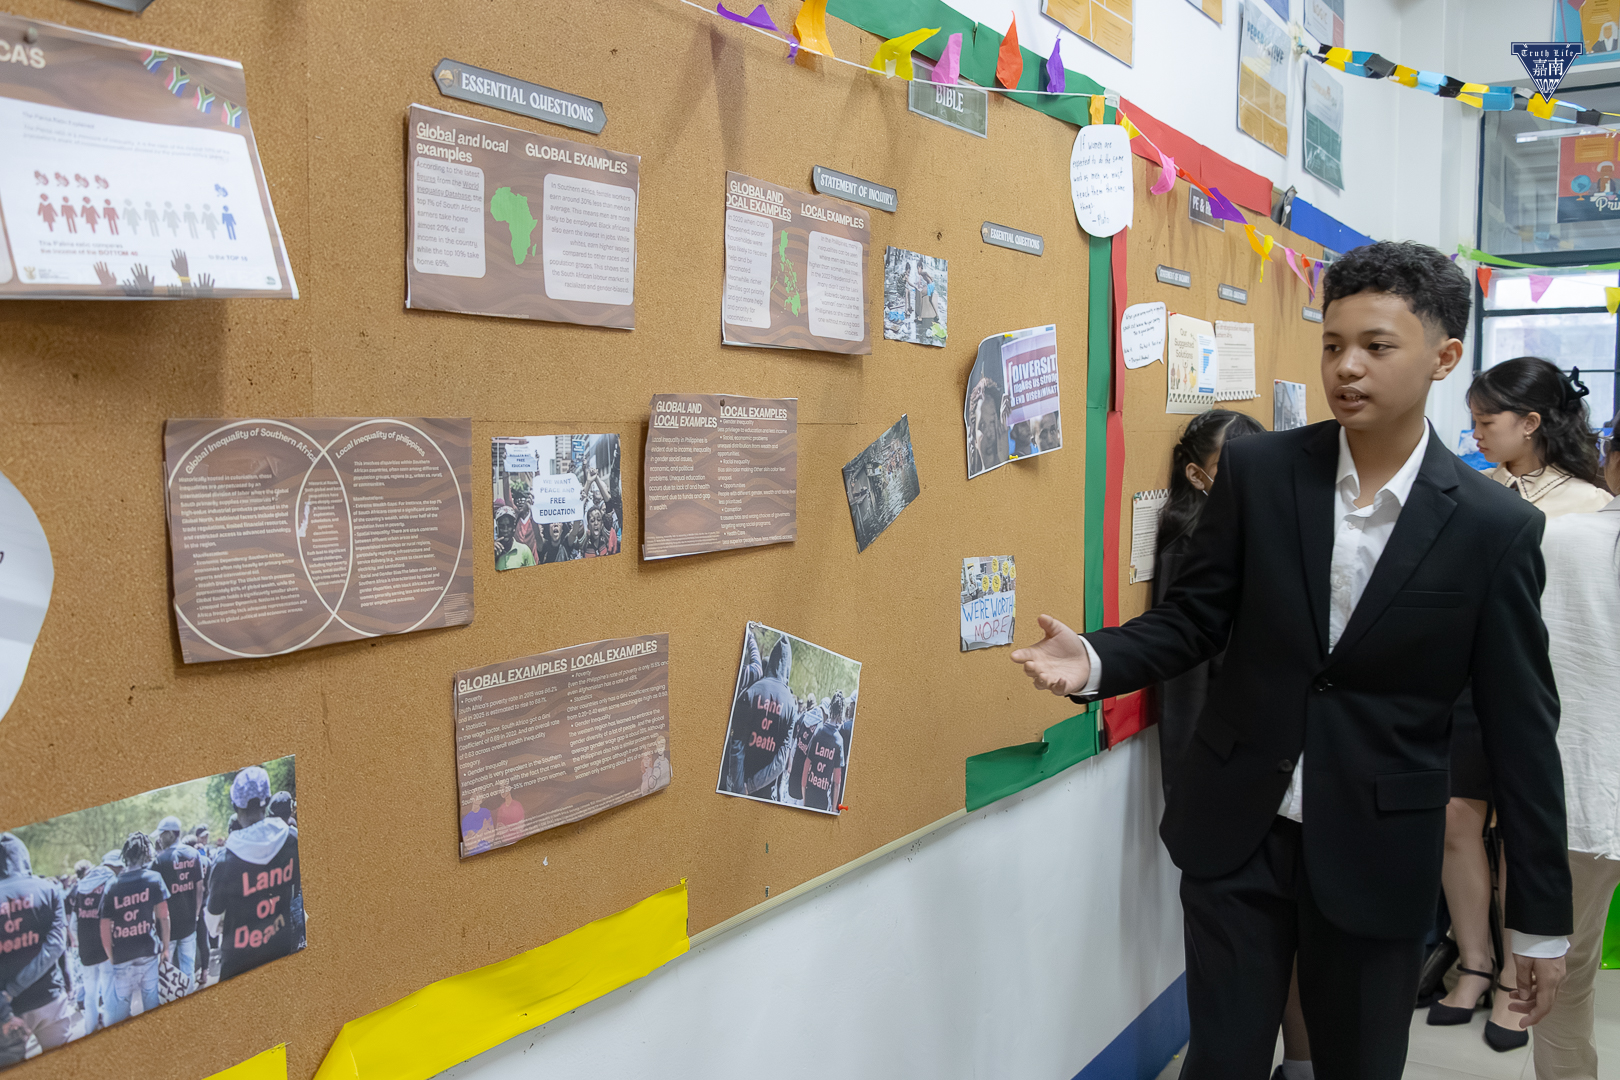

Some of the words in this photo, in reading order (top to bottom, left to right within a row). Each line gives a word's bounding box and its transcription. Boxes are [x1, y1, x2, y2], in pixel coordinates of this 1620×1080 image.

[462, 73, 526, 105] ESSENTIAL
[530, 92, 593, 123] QUESTIONS
[936, 84, 964, 113] BIBLE
[417, 122, 455, 140] Global
[458, 132, 479, 149] and
[482, 134, 508, 153] local
[417, 142, 472, 163] examples
[526, 143, 572, 164] GLOBAL
[574, 153, 628, 174] EXAMPLES
[1091, 154, 1096, 164] to
[416, 160, 445, 173] According
[453, 167, 463, 175] the
[451, 178, 461, 186] the
[462, 180, 479, 189] World
[821, 174, 857, 195] STATEMENT
[858, 185, 867, 198] OF
[869, 188, 894, 206] INQUIRY
[1091, 185, 1103, 196] them
[730, 180, 766, 199] GLOBAL
[767, 190, 783, 204] AND
[416, 197, 426, 205] top
[435, 199, 441, 207] of
[442, 201, 459, 210] South
[750, 198, 792, 220] EXAMPLES
[1192, 196, 1199, 210] PE
[1200, 198, 1205, 213] &
[438, 212, 451, 220] take
[452, 214, 468, 223] home
[801, 203, 827, 220] LOCAL
[827, 211, 864, 229] EXAMPLES
[436, 223, 449, 232] 20%
[450, 225, 457, 233] of
[444, 236, 454, 244] the
[990, 228, 1014, 243] ESSENTIAL
[1015, 235, 1040, 250] QUESTIONS
[416, 257, 434, 265] home
[467, 251, 479, 259] take
[1176, 349, 1193, 359] Solutions
[1014, 380, 1032, 393] makes
[1032, 378, 1040, 388] us
[656, 401, 685, 413] GLOBAL
[687, 403, 702, 413] AND
[720, 406, 747, 417] LOCAL
[749, 407, 787, 419] EXAMPLES
[654, 415, 679, 427] LOCAL
[680, 416, 717, 428] EXAMPLES
[185, 448, 209, 474] Global
[208, 430, 249, 452] Inequality
[250, 428, 260, 437] of
[260, 428, 297, 446] Southern
[335, 440, 354, 459] Local
[354, 431, 388, 446] Inequality
[388, 431, 396, 439] of
[396, 434, 425, 457] philippines
[540, 508, 576, 516] EDUCATION
[991, 595, 1013, 618] WORTH
[975, 615, 1009, 641] MORE
[570, 652, 605, 669] LOCAL
[606, 640, 658, 661] EXAMPLES
[458, 674, 505, 693] GLOBAL
[507, 659, 568, 682] EXAMPLES
[575, 670, 592, 679] Poverty
[464, 694, 482, 705] Poverty
[573, 692, 592, 702] Statistics
[757, 695, 784, 715] Land
[465, 720, 486, 731] Statistics
[574, 718, 590, 727] Gender
[762, 718, 773, 730] or
[815, 742, 835, 760] Land
[467, 766, 484, 776] Gender
[817, 762, 826, 772] or
[173, 858, 195, 870] Land
[179, 872, 189, 881] or
[242, 858, 293, 897] Land
[114, 888, 150, 909] Land
[256, 896, 280, 919] or
[124, 909, 139, 922] or
[4, 917, 23, 933] or
